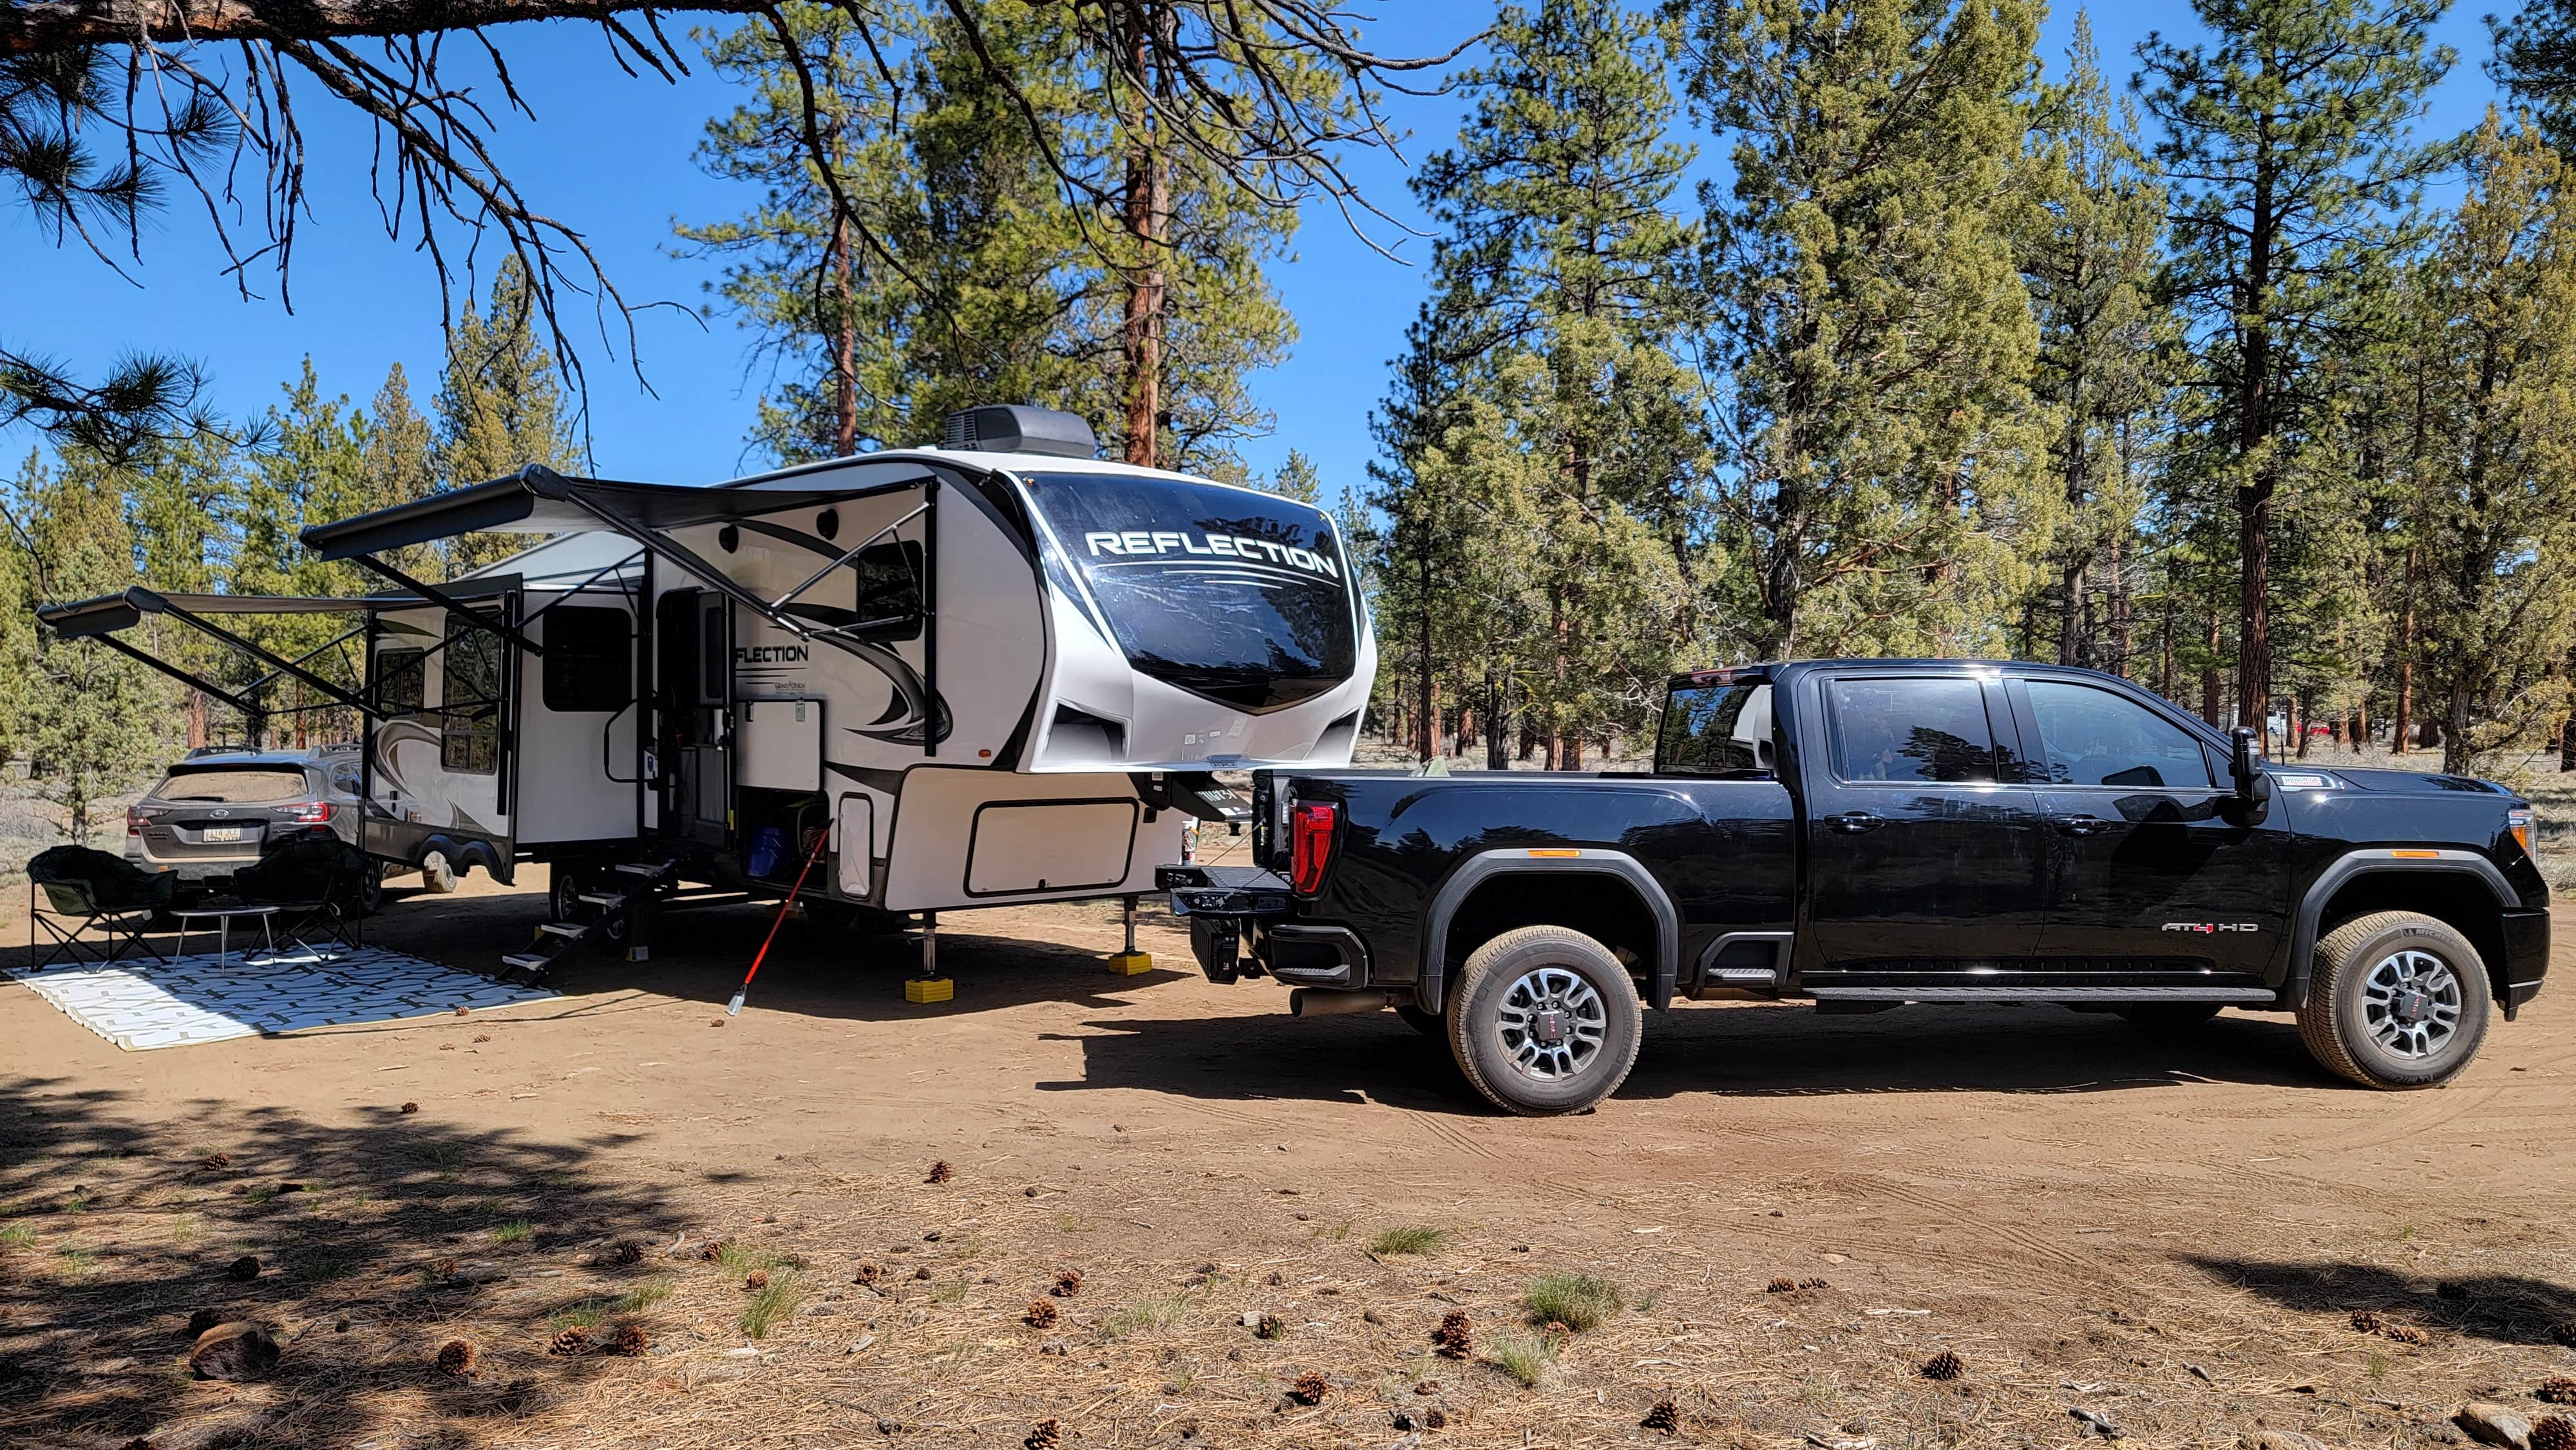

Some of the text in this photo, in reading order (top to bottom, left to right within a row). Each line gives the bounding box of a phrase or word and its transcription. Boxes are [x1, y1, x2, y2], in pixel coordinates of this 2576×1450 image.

[1084, 531, 1340, 579] REFLECTION
[736, 645, 808, 663] FLECTION
[2161, 923, 2259, 934] AT4 HD
